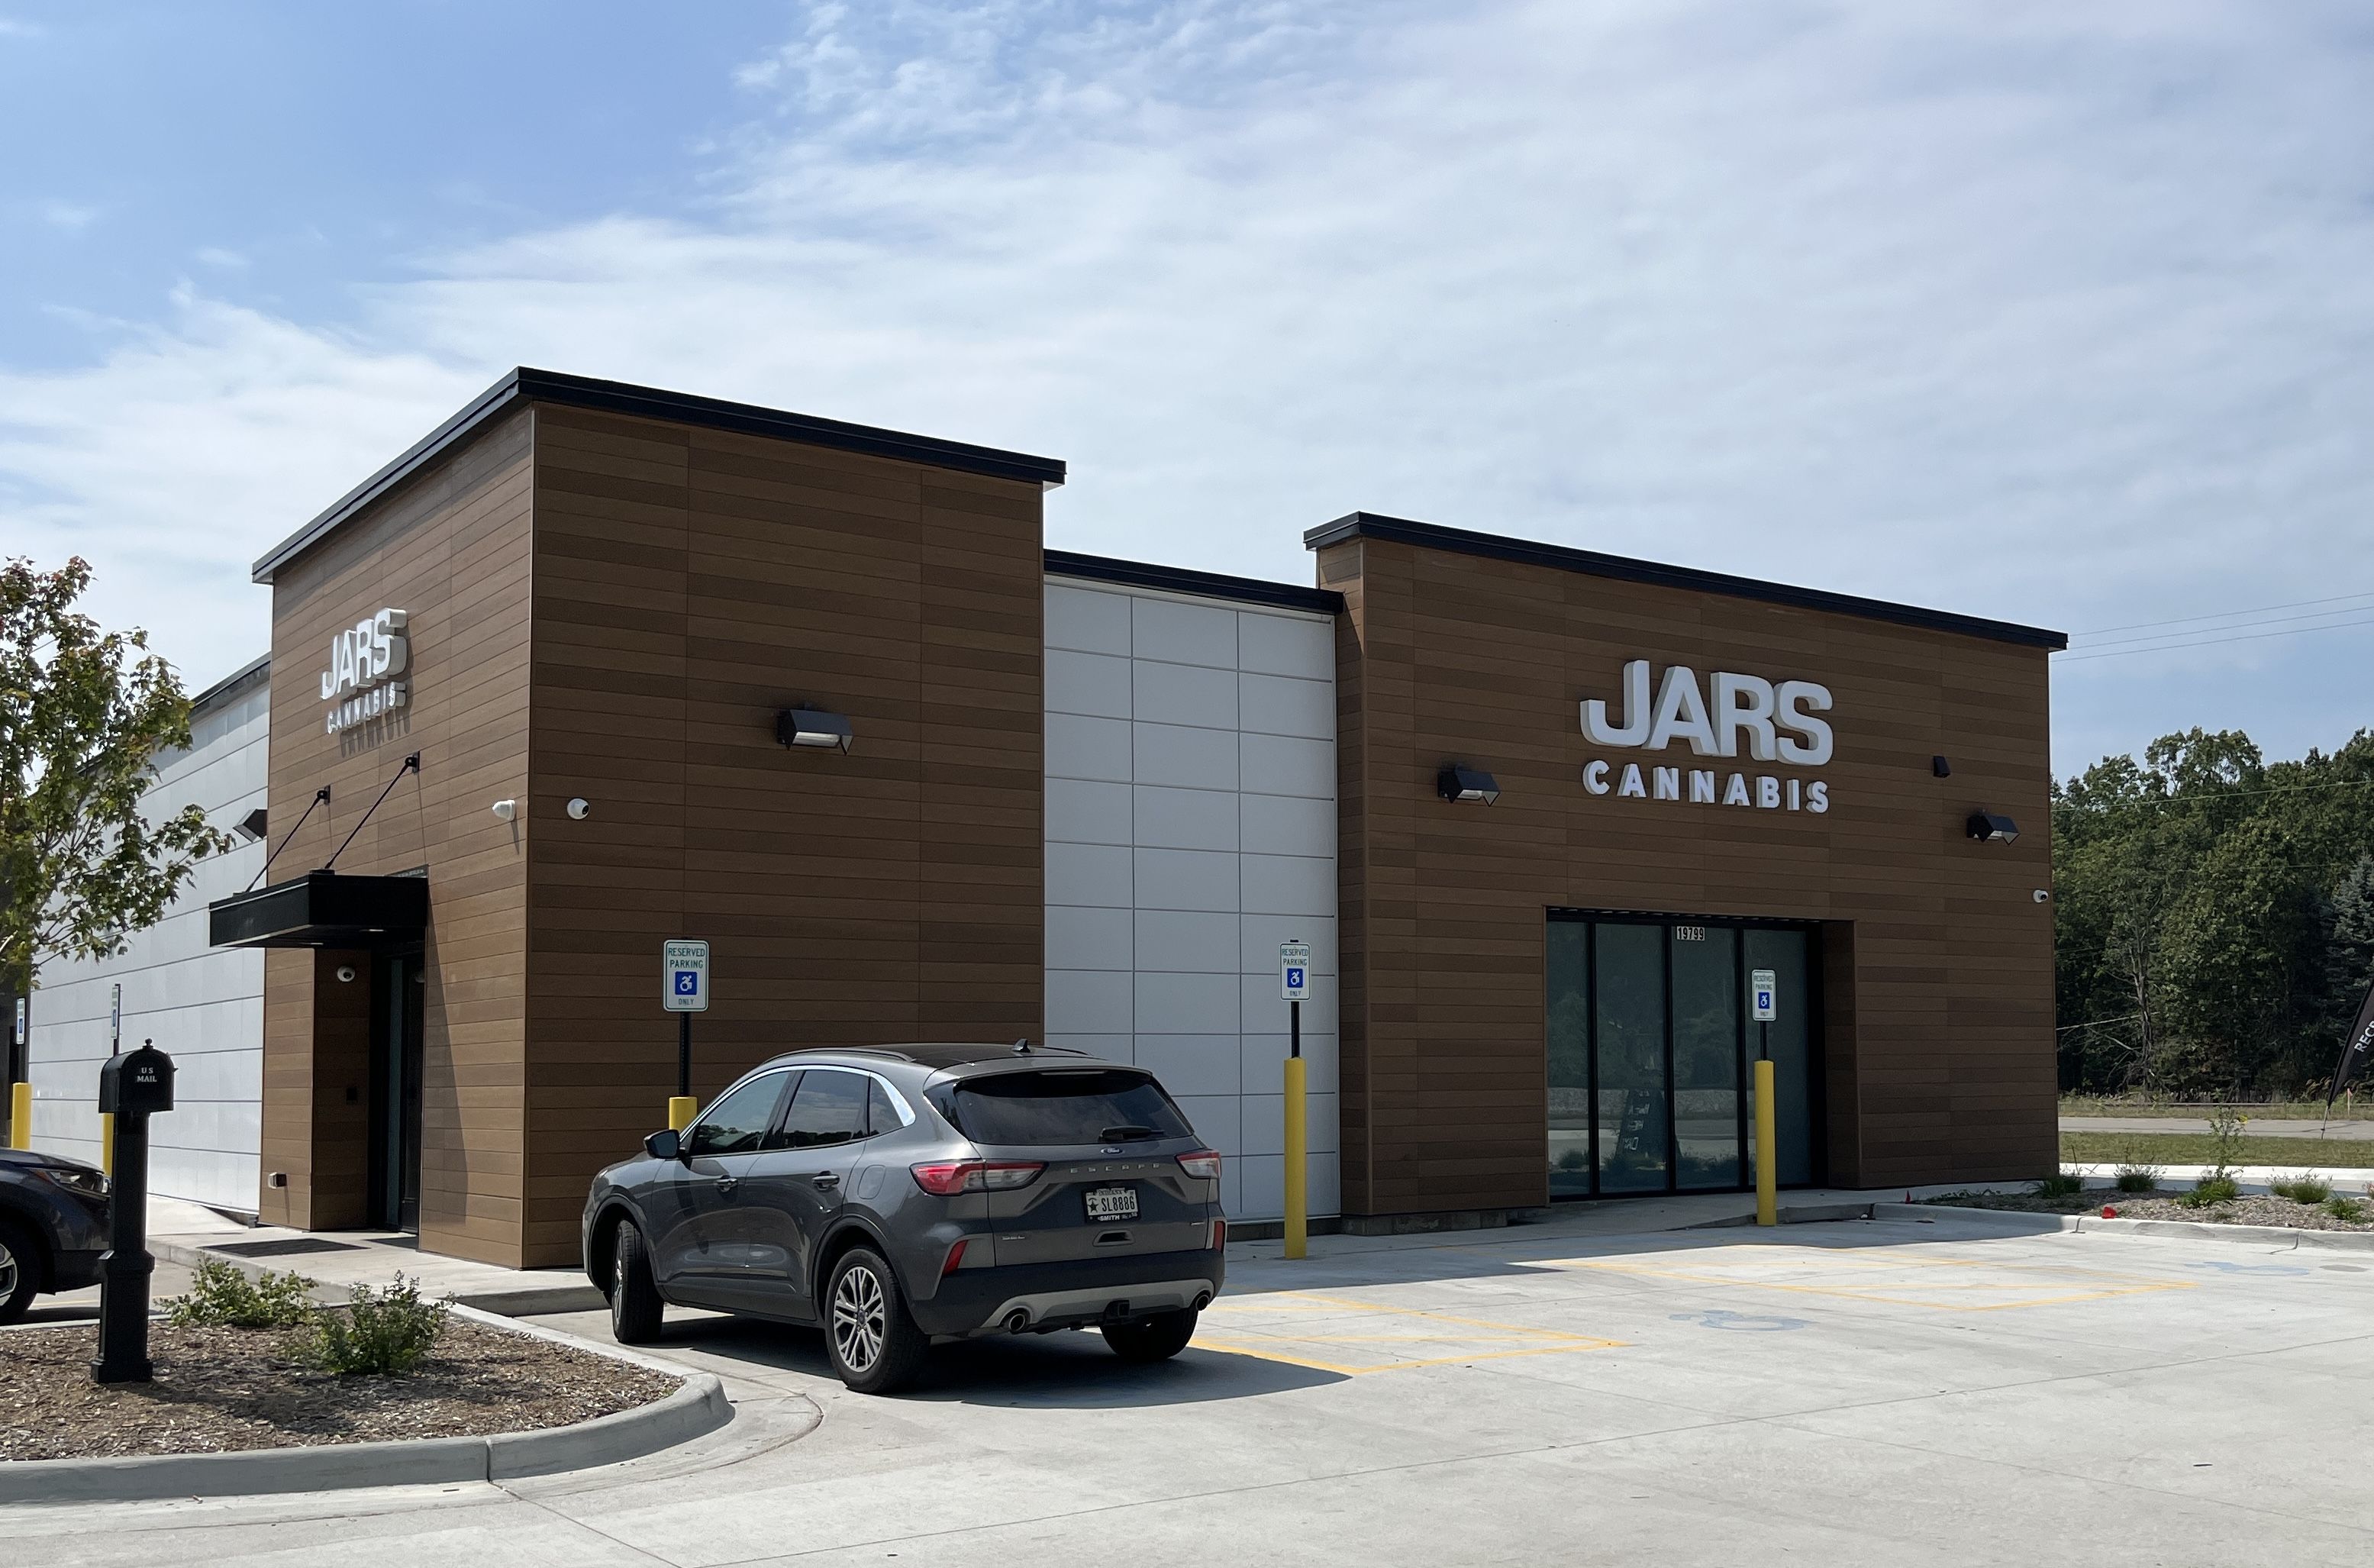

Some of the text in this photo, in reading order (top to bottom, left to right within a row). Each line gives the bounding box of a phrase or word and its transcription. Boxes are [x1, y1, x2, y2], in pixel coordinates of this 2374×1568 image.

[321, 608, 408, 700] JARS
[327, 681, 406, 735] CANNABIS
[1579, 659, 1833, 766] JARS
[1582, 760, 1829, 814] CANNABIS
[1678, 927, 1704, 940] 19799
[667, 947, 705, 957] RESERVED
[669, 959, 704, 969] PARKING
[1283, 958, 1307, 966] PARKING
[1070, 1163, 1160, 1173] ESCAPE
[1101, 1196, 1135, 1211] SL8886
